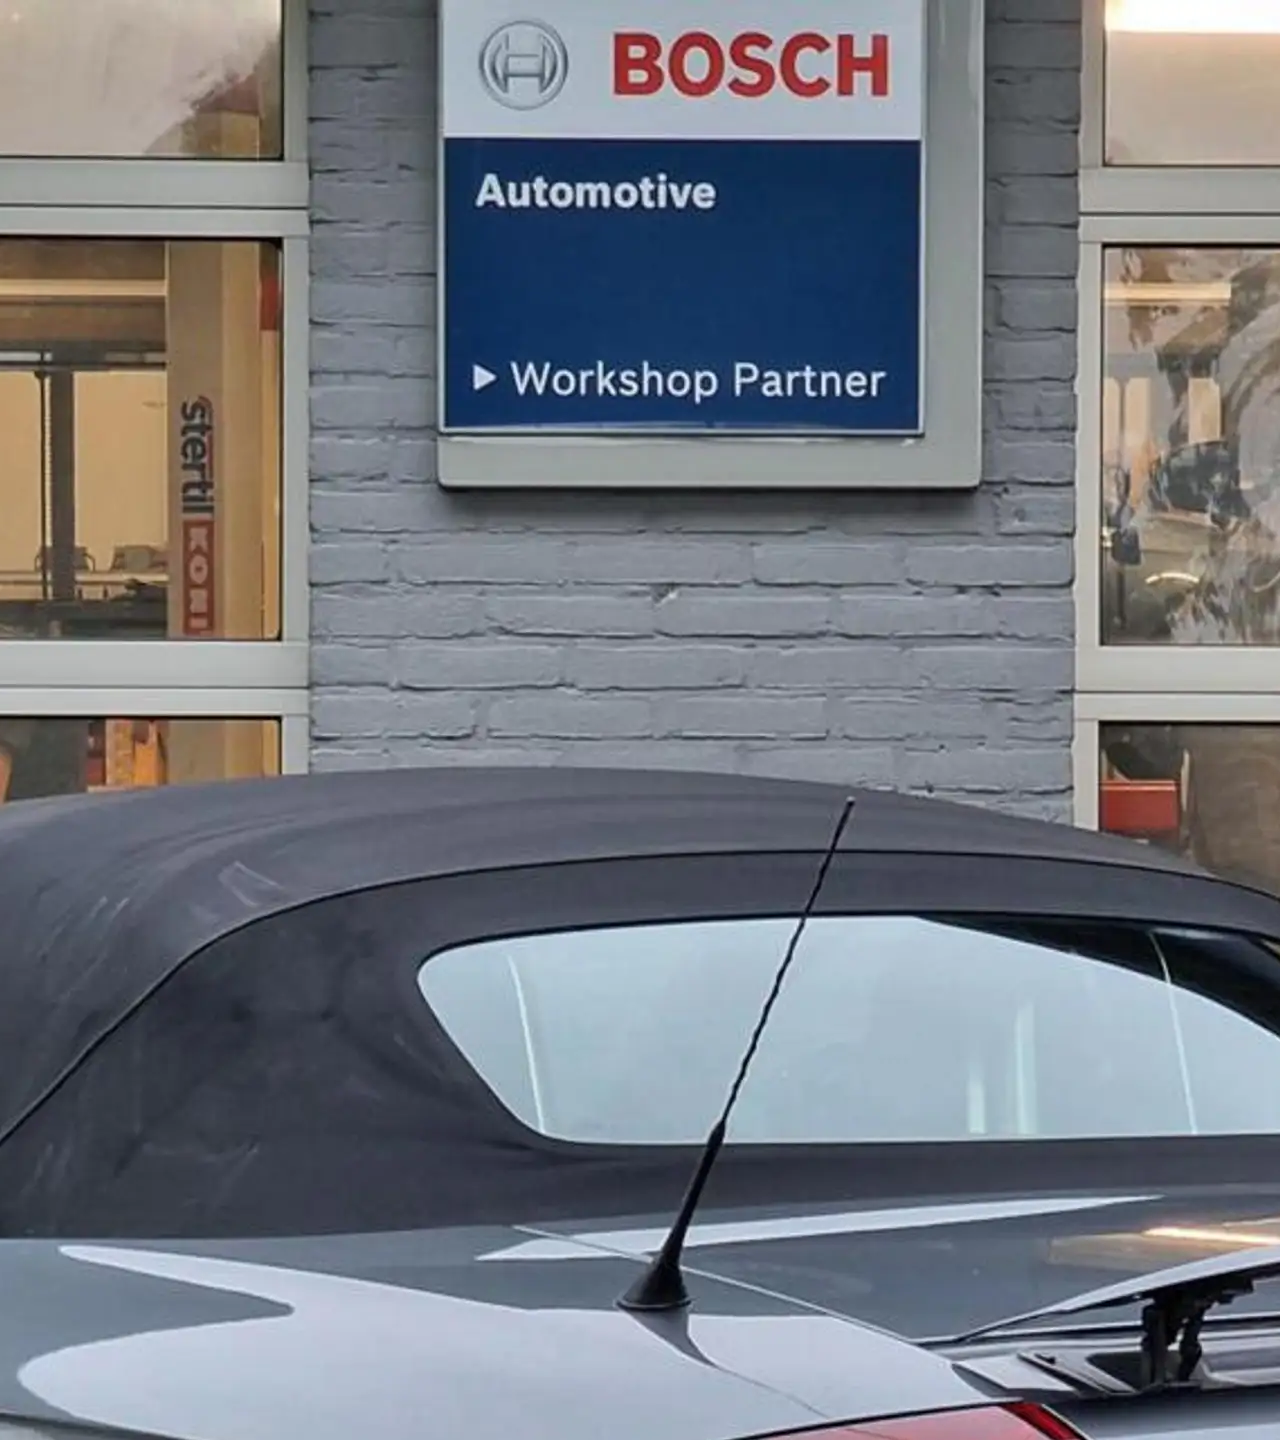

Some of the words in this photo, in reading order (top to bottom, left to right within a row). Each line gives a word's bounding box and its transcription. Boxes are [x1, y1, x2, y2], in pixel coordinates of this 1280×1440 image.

[613, 32, 889, 98] BOSCH
[475, 173, 717, 209] Automotive
[511, 361, 718, 404] Workshop
[734, 362, 886, 398] Partner
[181, 400, 214, 514] stertil
